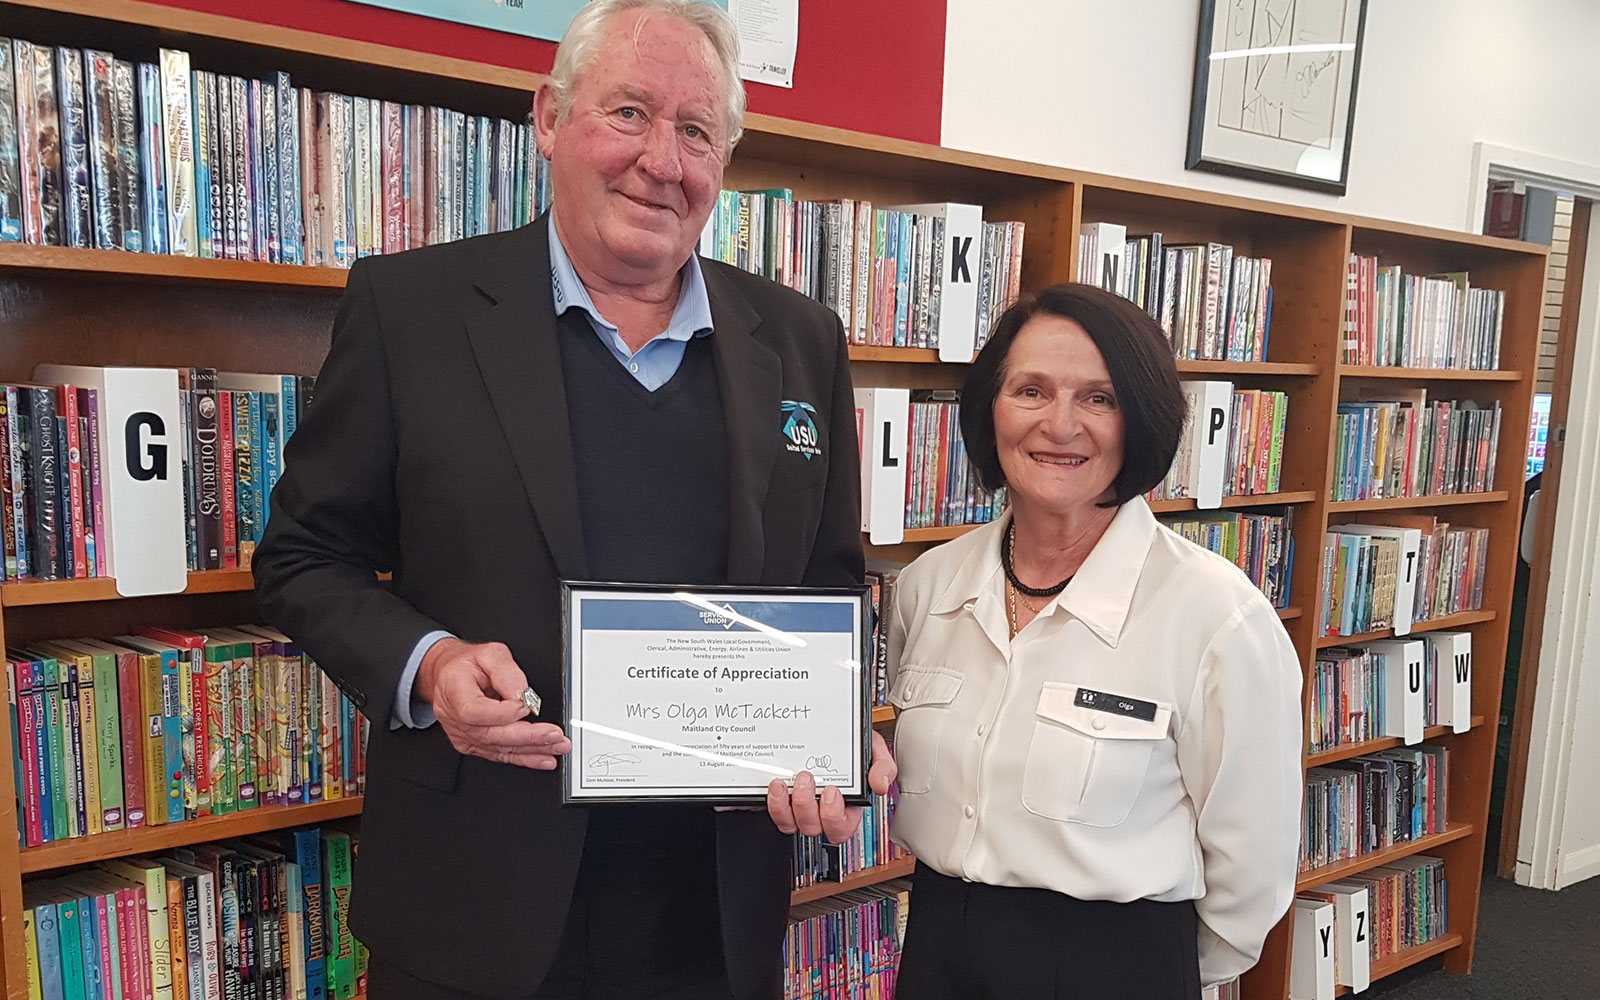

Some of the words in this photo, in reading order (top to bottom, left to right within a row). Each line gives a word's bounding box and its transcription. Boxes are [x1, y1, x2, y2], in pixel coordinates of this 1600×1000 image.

[951, 237, 973, 283] K
[1102, 253, 1119, 292] N
[39, 416, 54, 454] GHOST
[236, 396, 249, 442] SWEET
[1208, 407, 1225, 445] P
[124, 411, 168, 482] G
[790, 425, 817, 447] USU
[882, 421, 899, 468] L
[238, 442, 252, 482] PIZZA
[266, 442, 276, 466] spy
[41, 455, 56, 497] KNIGHT
[196, 423, 222, 520] DOLDRUMS
[1406, 551, 1416, 583] T
[627, 666, 700, 680] Certificate
[702, 665, 718, 680] of
[721, 666, 810, 682] Appreciation
[692, 653, 711, 661] hereby
[711, 653, 735, 661] presents
[1455, 652, 1470, 684] W
[1409, 661, 1420, 694] U
[193, 690, 203, 732] 13-STOREY
[626, 703, 661, 719] Mrs
[667, 703, 708, 725] Olga
[714, 703, 811, 719] McTackett
[1118, 701, 1135, 711] Olga
[105, 716, 115, 740] Verity
[715, 725, 729, 733] City
[196, 735, 206, 781] TREEHOUSE
[187, 885, 195, 899] THE
[170, 902, 182, 930] Kerenza
[186, 899, 198, 927] BLUE
[222, 889, 239, 938] COSMIC
[303, 884, 323, 962] DARKMOUTH
[332, 886, 353, 961] DARKMOUTH
[1356, 910, 1366, 943] Z
[188, 928, 201, 955] LADY
[206, 940, 219, 960] RUBY
[282, 943, 290, 969] DANGER
[1319, 925, 1331, 958] Y
[154, 939, 171, 979] Slider
[208, 973, 219, 999] OLIVIA
